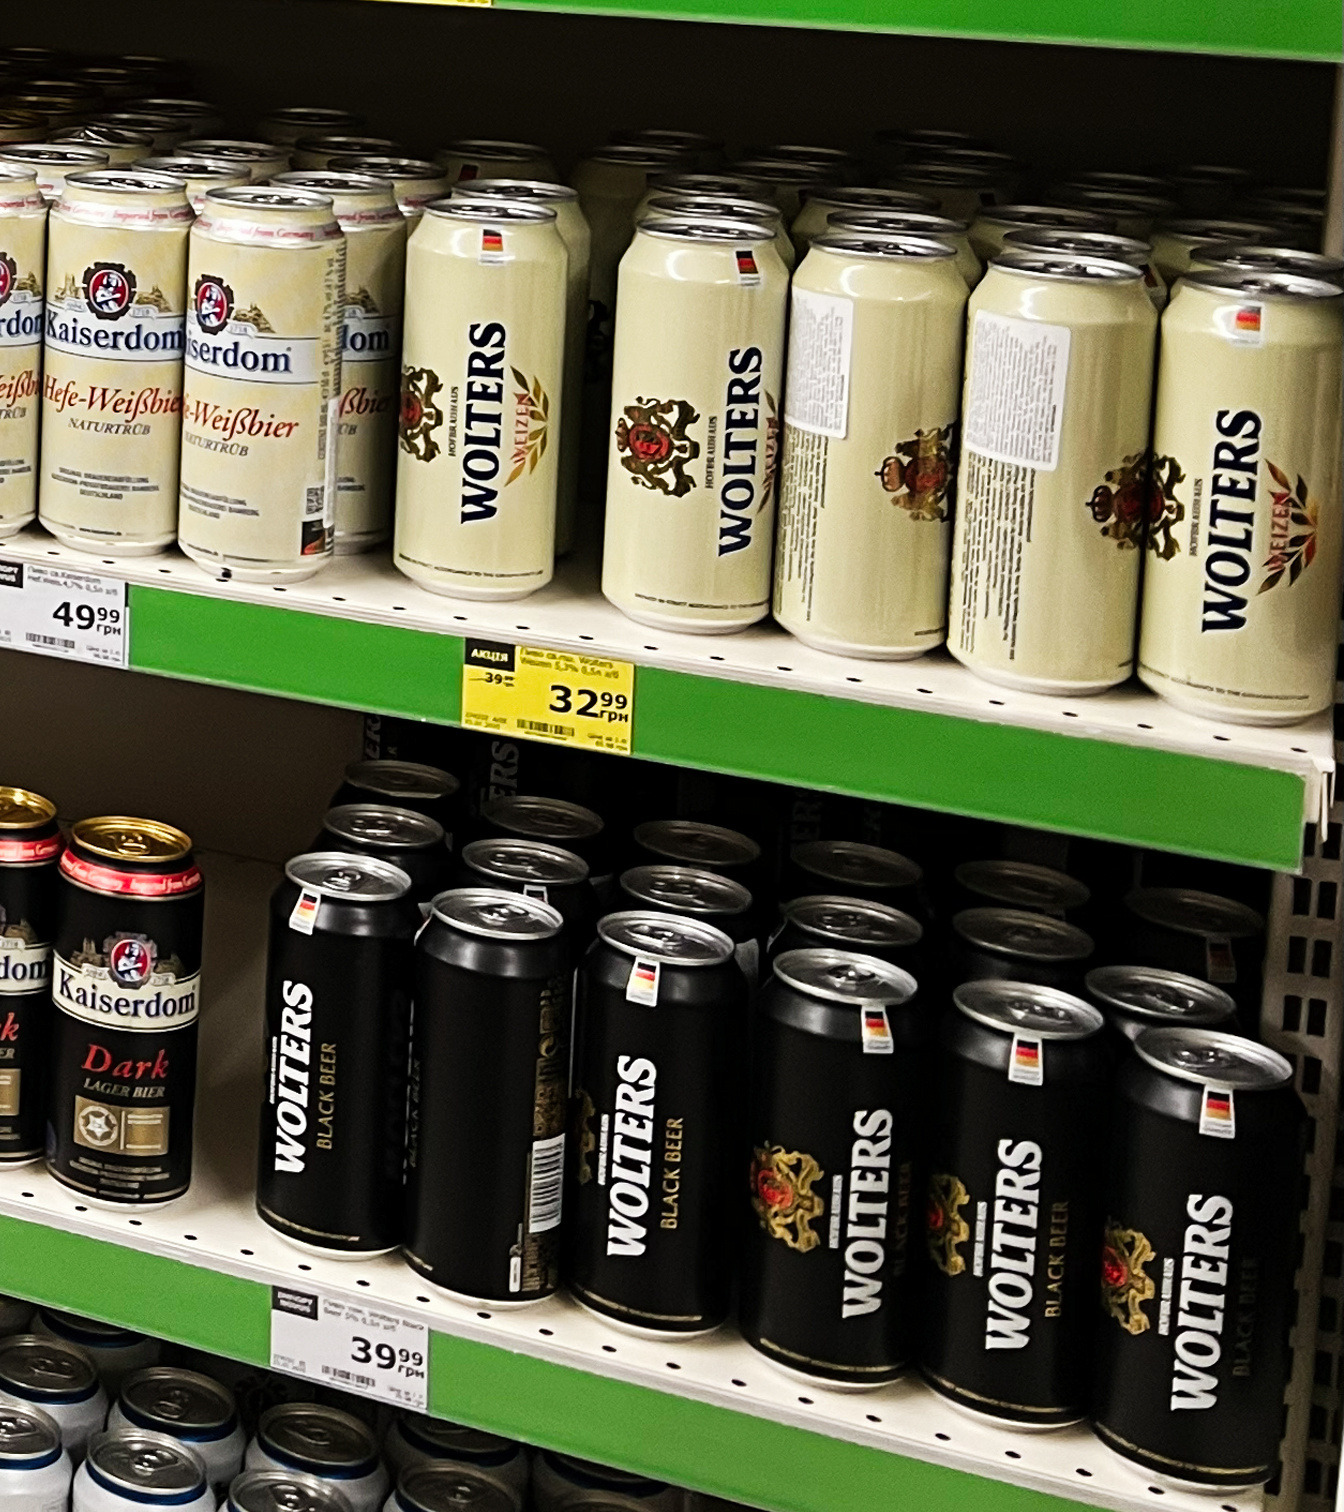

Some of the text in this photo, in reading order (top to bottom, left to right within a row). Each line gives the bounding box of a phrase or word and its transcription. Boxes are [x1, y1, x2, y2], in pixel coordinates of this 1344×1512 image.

[44, 313, 184, 353] Kaiserdom
[68, 418, 151, 436] NATURTRÜB
[461, 321, 506, 525] WOLTERS
[718, 346, 764, 557] WOLTERS
[1202, 408, 1262, 634] WOLTERS
[52, 600, 121, 631] 49 99
[471, 648, 509, 663] АКЦІЯ
[548, 686, 629, 724] 32 99 грн
[53, 969, 197, 1018] Kaiserdom
[81, 1044, 169, 1081] Dark
[274, 980, 313, 1176] WOLTERS
[606, 1055, 658, 1259] WOLTERS
[841, 1108, 894, 1321] WOLTERS
[984, 1137, 1043, 1353] WOLTERS
[1169, 1192, 1235, 1412] WOLTERS
[349, 1336, 424, 1370] 39 99
